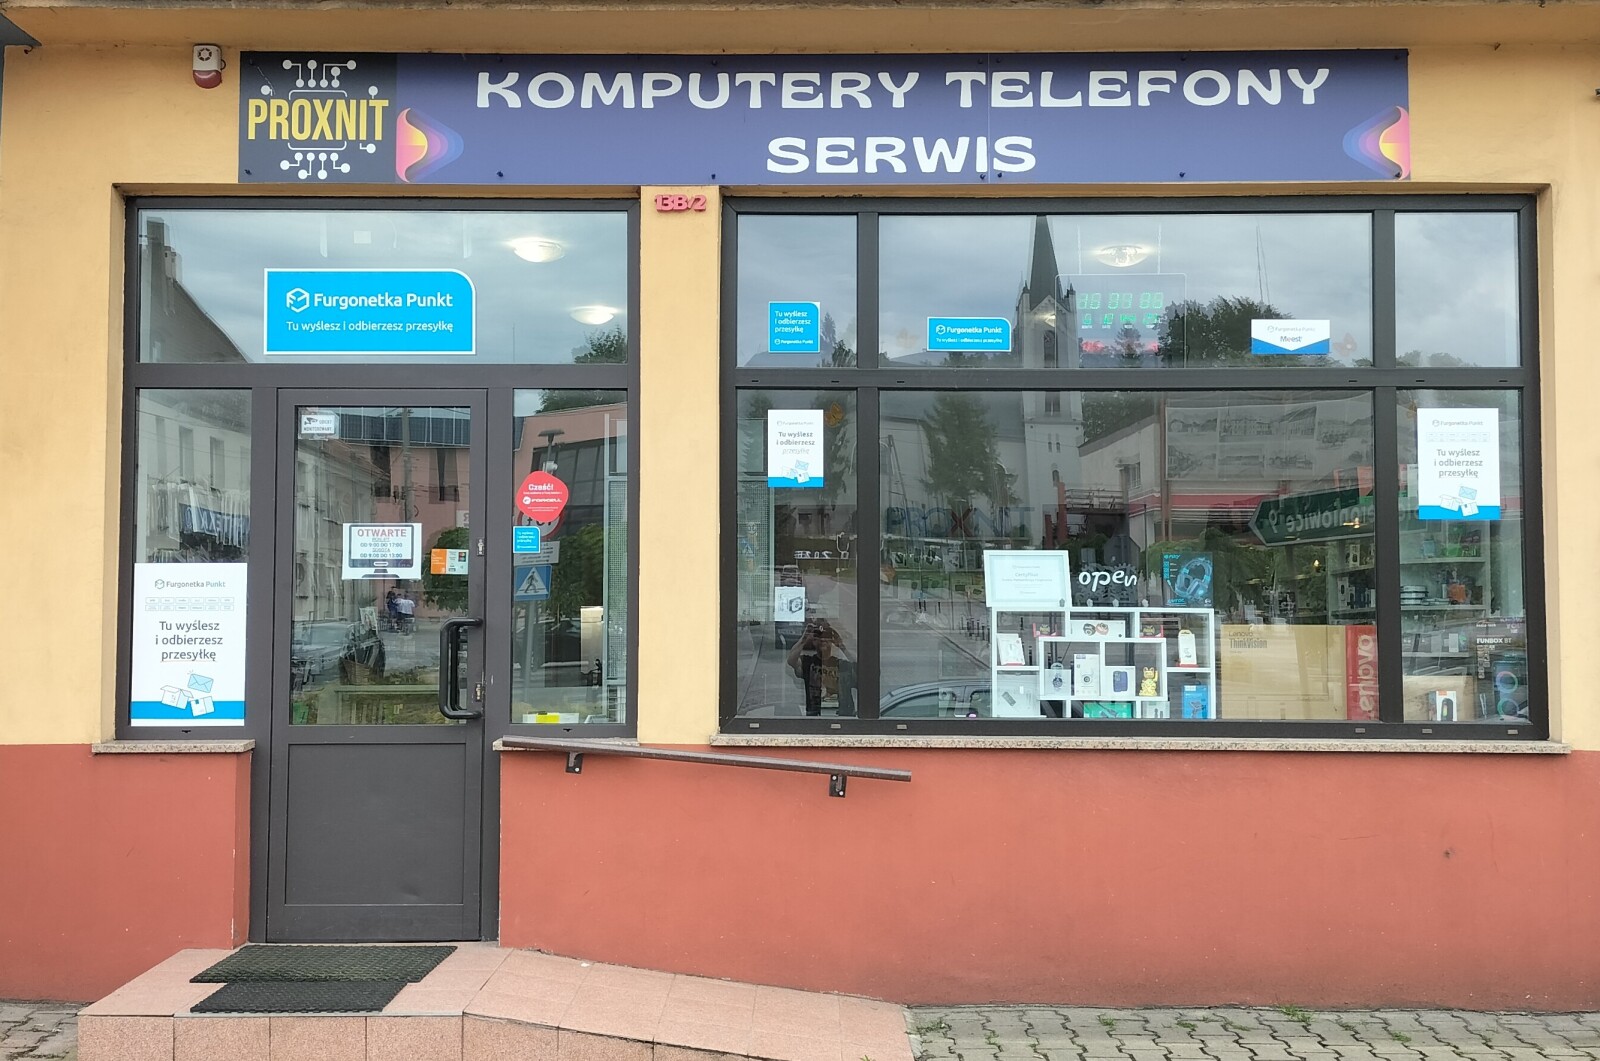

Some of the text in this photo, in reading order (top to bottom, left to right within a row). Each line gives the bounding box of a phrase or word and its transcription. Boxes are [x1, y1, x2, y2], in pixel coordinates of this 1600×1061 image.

[476, 67, 1330, 110] KOMPUTERY TELEFONY
[248, 98, 389, 141] PROXNIT
[766, 135, 1037, 175] SERWIS
[655, 193, 707, 213] 13B/2
[314, 292, 453, 311] Furgonetka Punkt
[783, 310, 808, 318] wyślesz
[286, 321, 299, 331] Tu
[301, 320, 340, 334] wyślesz
[348, 321, 403, 332] odbierzesz
[405, 321, 454, 334] przesyłkę
[946, 326, 1003, 334] Furgonetka Punkt
[1437, 448, 1480, 458] Tu wyślesz
[1439, 459, 1483, 467] odbierzesz
[1438, 468, 1479, 479] przesyłkę
[357, 528, 407, 538] OTWARTE
[166, 580, 226, 589] Furgonetka Punkt
[1078, 570, 1137, 592] open
[159, 619, 220, 633] Tu wyślesz
[155, 634, 223, 646] i odbierzesz
[1228, 638, 1268, 649] ThinkVision
[161, 648, 217, 662] przesyłkę
